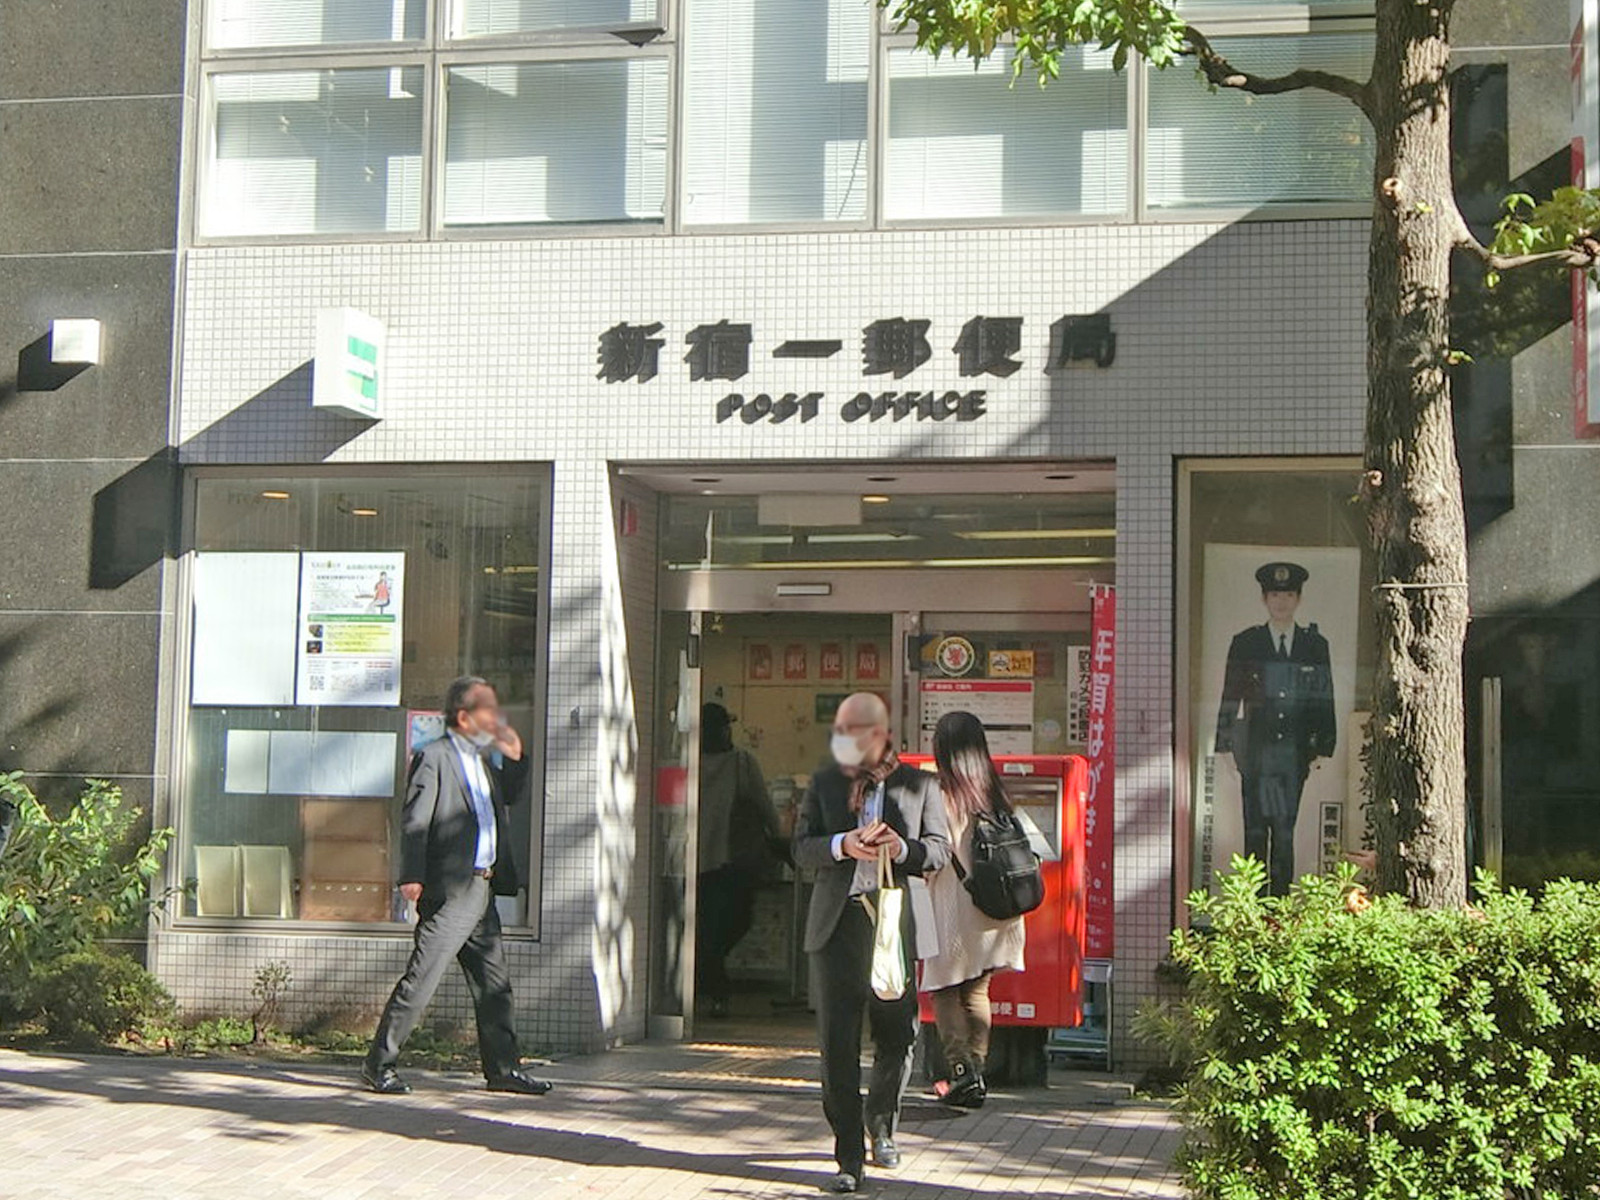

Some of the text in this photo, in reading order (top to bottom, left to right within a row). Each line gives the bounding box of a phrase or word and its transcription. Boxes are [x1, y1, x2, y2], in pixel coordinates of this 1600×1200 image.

[596, 314, 1117, 383] 新宿一郵便局
[716, 390, 988, 424] POST OFFICE
